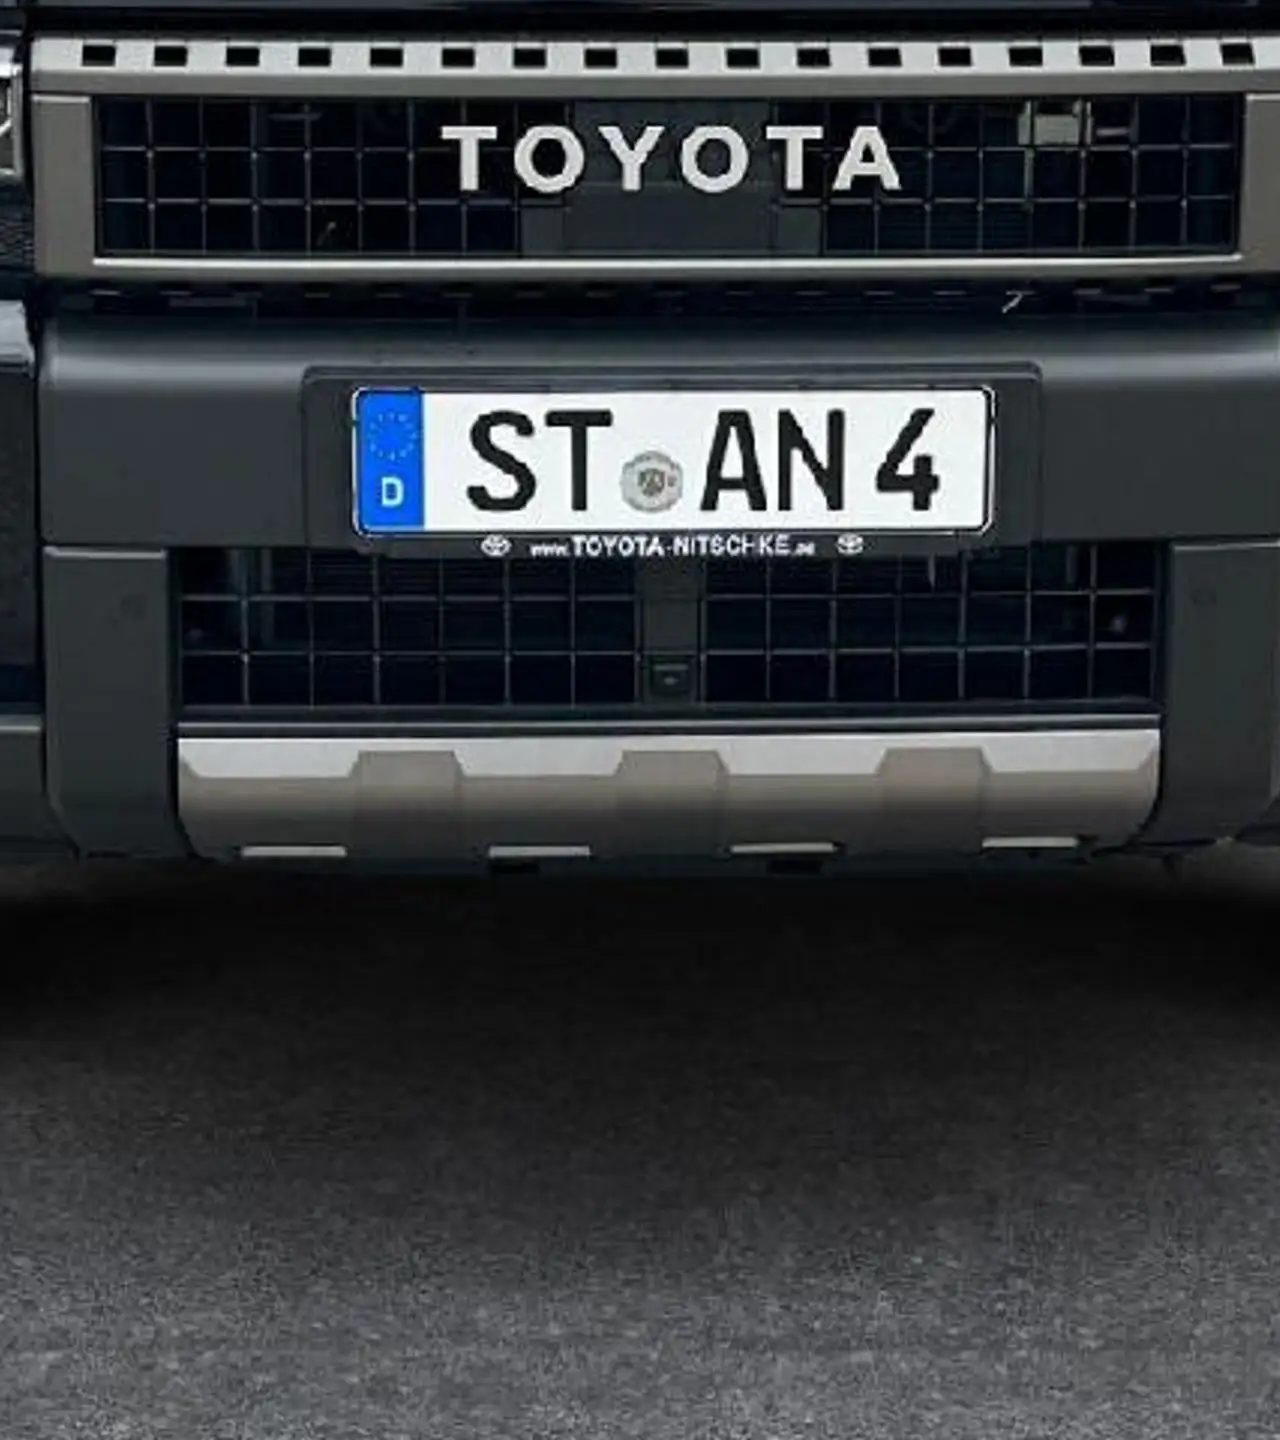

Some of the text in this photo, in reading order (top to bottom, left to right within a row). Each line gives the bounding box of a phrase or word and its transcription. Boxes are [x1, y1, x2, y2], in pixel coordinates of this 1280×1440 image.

[441, 125, 902, 193] TOYOTA
[381, 477, 404, 506] D
[466, 408, 941, 512] ST AN 4
